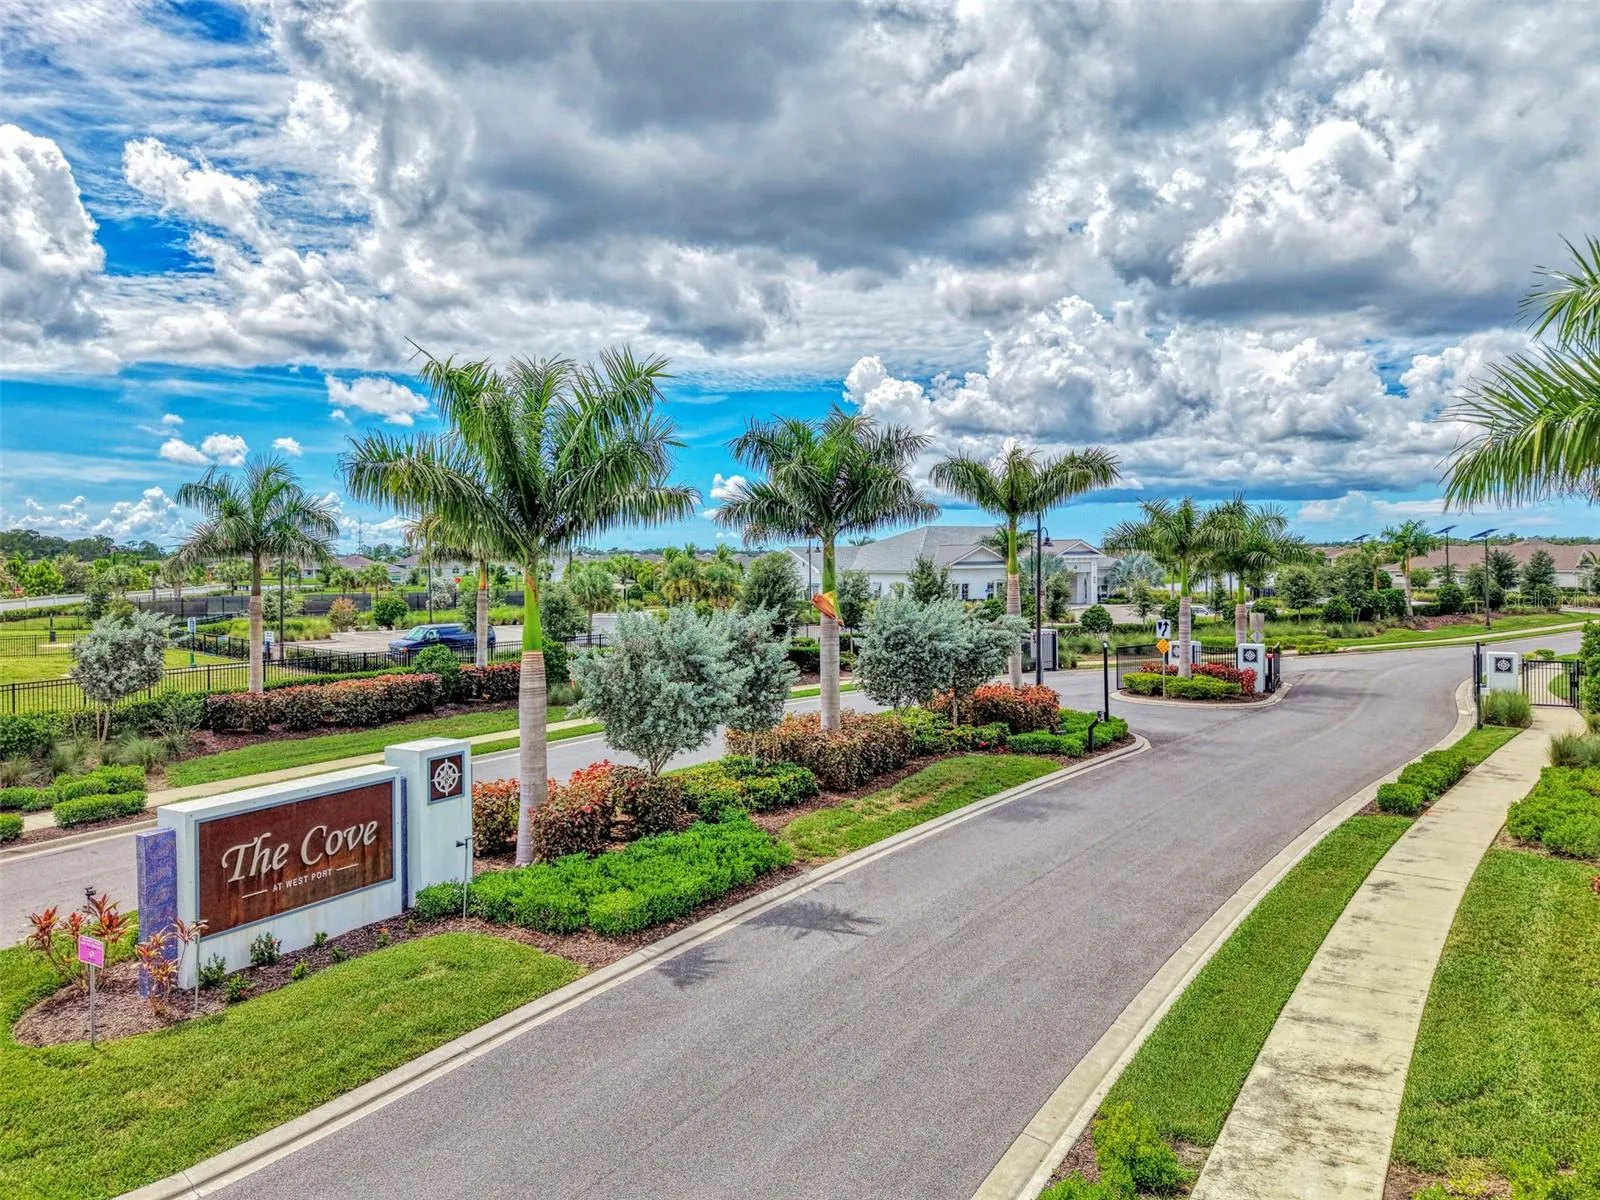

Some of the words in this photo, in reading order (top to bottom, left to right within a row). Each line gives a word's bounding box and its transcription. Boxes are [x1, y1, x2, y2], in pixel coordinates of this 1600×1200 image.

[222, 832, 289, 883] The
[300, 820, 378, 866] Cove
[272, 882, 283, 893] AT
[285, 875, 309, 889] WEST
[311, 868, 333, 881] PORT
